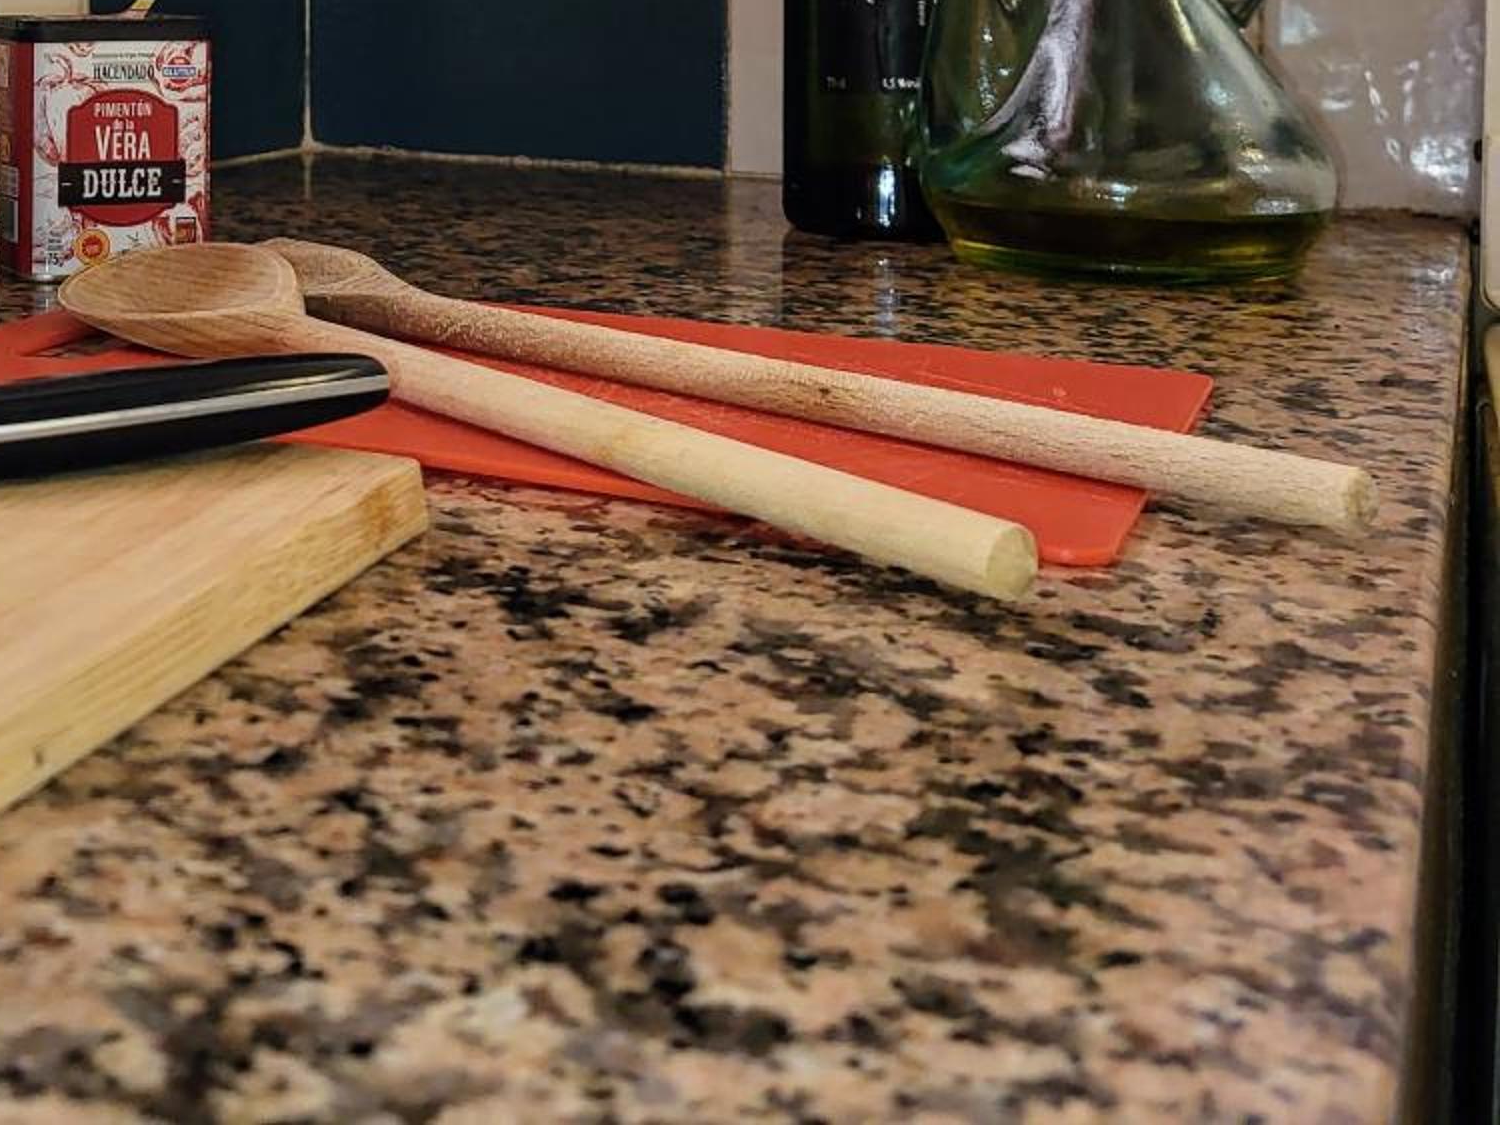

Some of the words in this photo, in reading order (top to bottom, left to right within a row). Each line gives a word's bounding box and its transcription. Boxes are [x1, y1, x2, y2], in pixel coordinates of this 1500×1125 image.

[92, 64, 155, 80] HACENDADO
[93, 99, 153, 118] PIMENTÓN
[95, 126, 151, 161] VERA
[83, 167, 163, 199] DULCE
